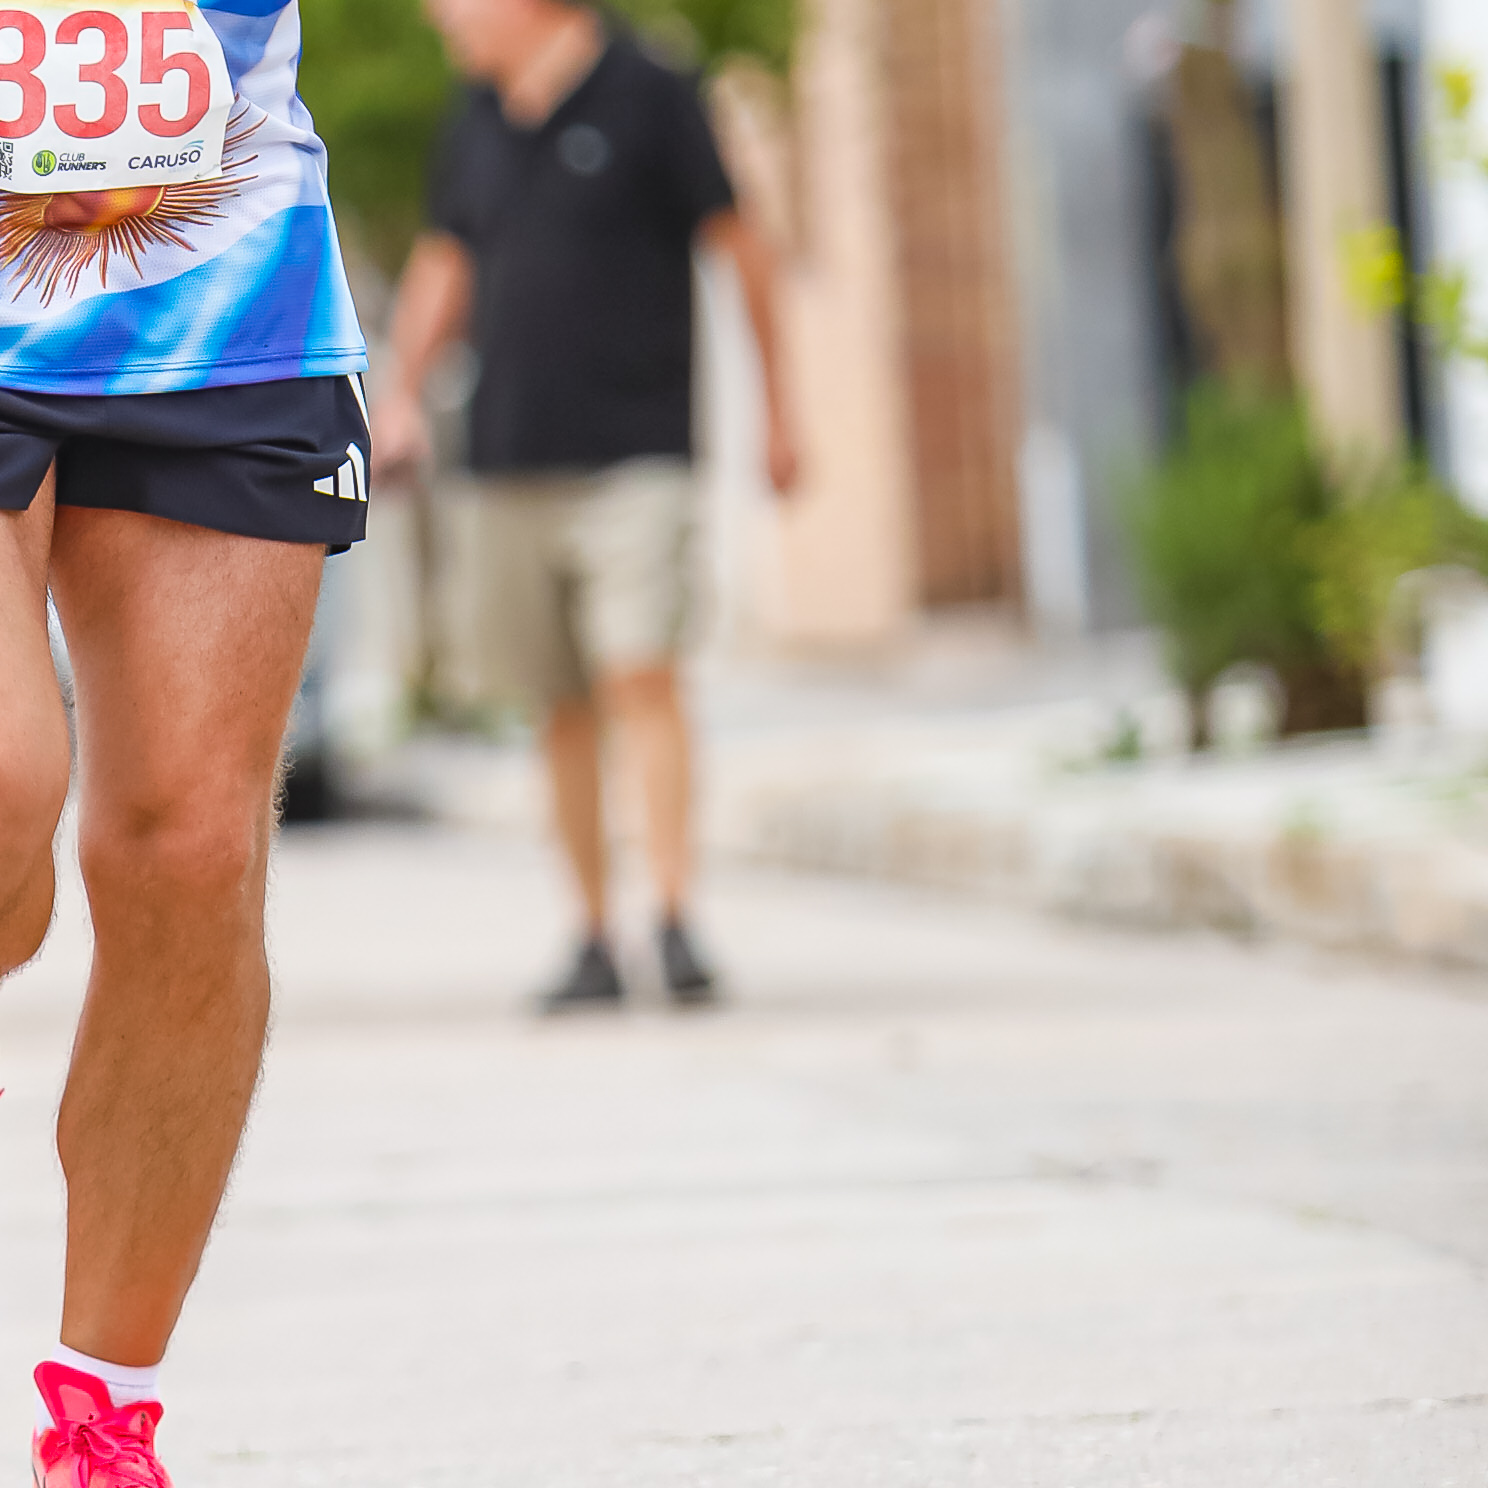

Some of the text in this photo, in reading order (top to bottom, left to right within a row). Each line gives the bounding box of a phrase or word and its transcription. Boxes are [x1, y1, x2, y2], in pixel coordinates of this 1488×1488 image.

[59, 153, 85, 162] CLUB
[128, 150, 201, 170] CARUSO
[57, 161, 106, 171] RUNNER'S
